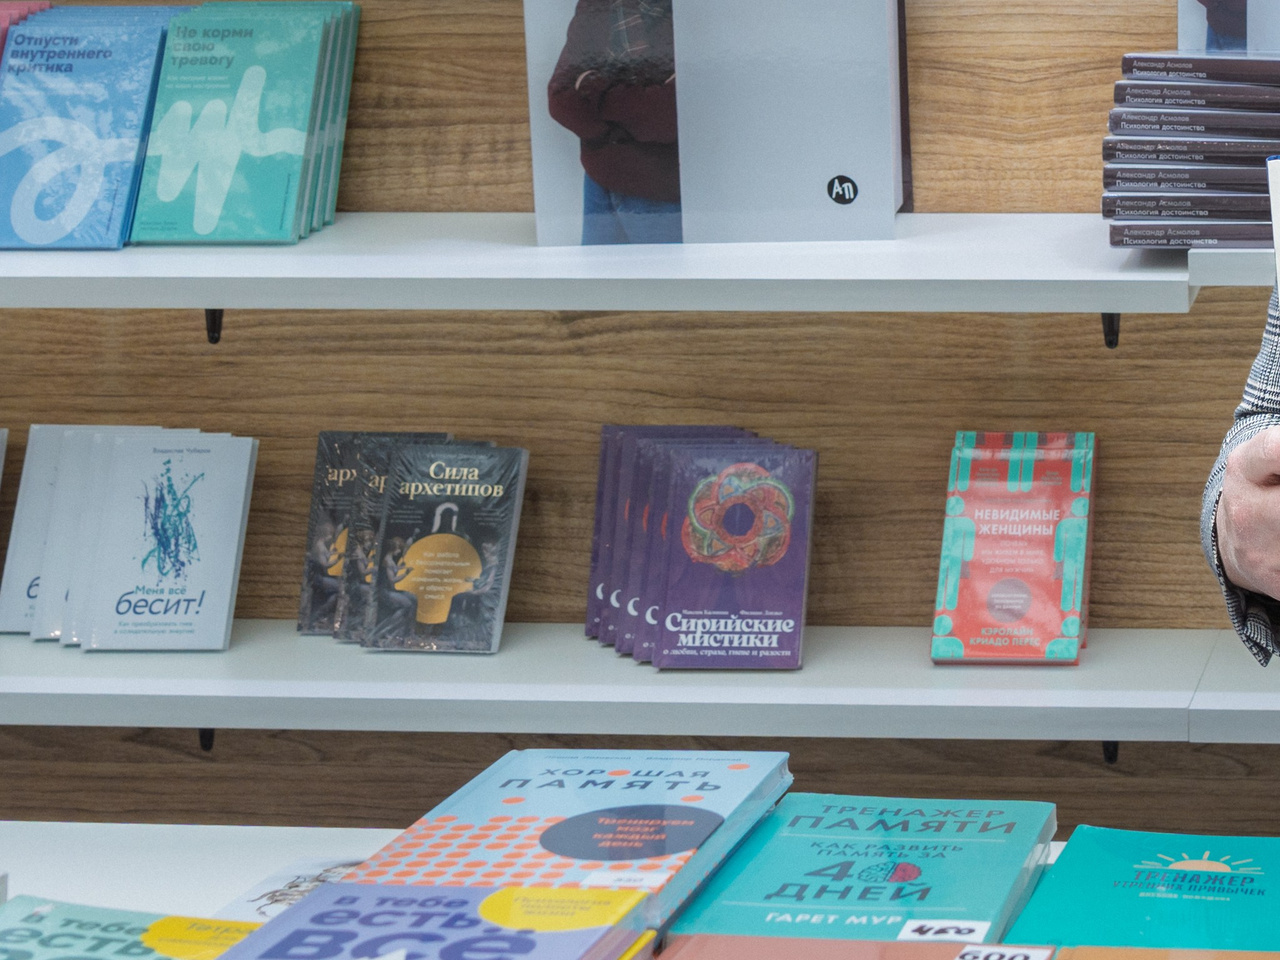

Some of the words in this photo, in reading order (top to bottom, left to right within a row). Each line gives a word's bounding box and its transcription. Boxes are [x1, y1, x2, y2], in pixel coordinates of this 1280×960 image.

[14, 34, 79, 49] Отпусти
[202, 28, 254, 41] корми
[173, 42, 215, 52] свою
[10, 49, 113, 62] внутреннего
[8, 62, 74, 76] критика
[171, 56, 235, 70] тревогу
[1115, 180, 1158, 189] Психология
[1159, 181, 1207, 189] достоинства
[429, 461, 479, 480] Сила
[400, 481, 504, 500] архетипов
[974, 508, 1060, 522] НЕВИДИМЫЕ
[979, 524, 1053, 536] ЖЕНЩИНЫ
[134, 585, 165, 596] Меня
[168, 585, 187, 596] всё
[115, 590, 206, 616] бесит!
[665, 613, 795, 636] Сирийские
[981, 626, 1034, 636] КЭРОЛАЙН
[677, 633, 779, 647] мистики
[970, 638, 1010, 646] КРИАДО
[1012, 638, 1041, 647] ПЕРЕС
[499, 778, 722, 791] ПАМЯТЬ
[822, 804, 1005, 818] ТРЕНАЖЕР
[598, 817, 695, 826] Тренируем
[787, 815, 1018, 834] ПАМЯТИ
[593, 832, 667, 840] каждый
[597, 840, 644, 848] день
[811, 841, 860, 851] КАК
[865, 842, 963, 853] РАЗВИТЬ
[816, 849, 909, 859] ПАМЯТЬ
[918, 851, 946, 859] ЗА
[1134, 870, 1255, 887] ТРЕНАЖЕР
[764, 881, 933, 902] ДНЕЙ
[1188, 884, 1267, 896] ПРИВЫЧЕК
[333, 896, 361, 905] в
[375, 895, 471, 909] тебе
[309, 910, 483, 930] есть
[765, 912, 839, 924] ГАРЕТ
[845, 914, 903, 925] МУР
[61, 918, 149, 935] тебе
[0, 927, 156, 956] есть
